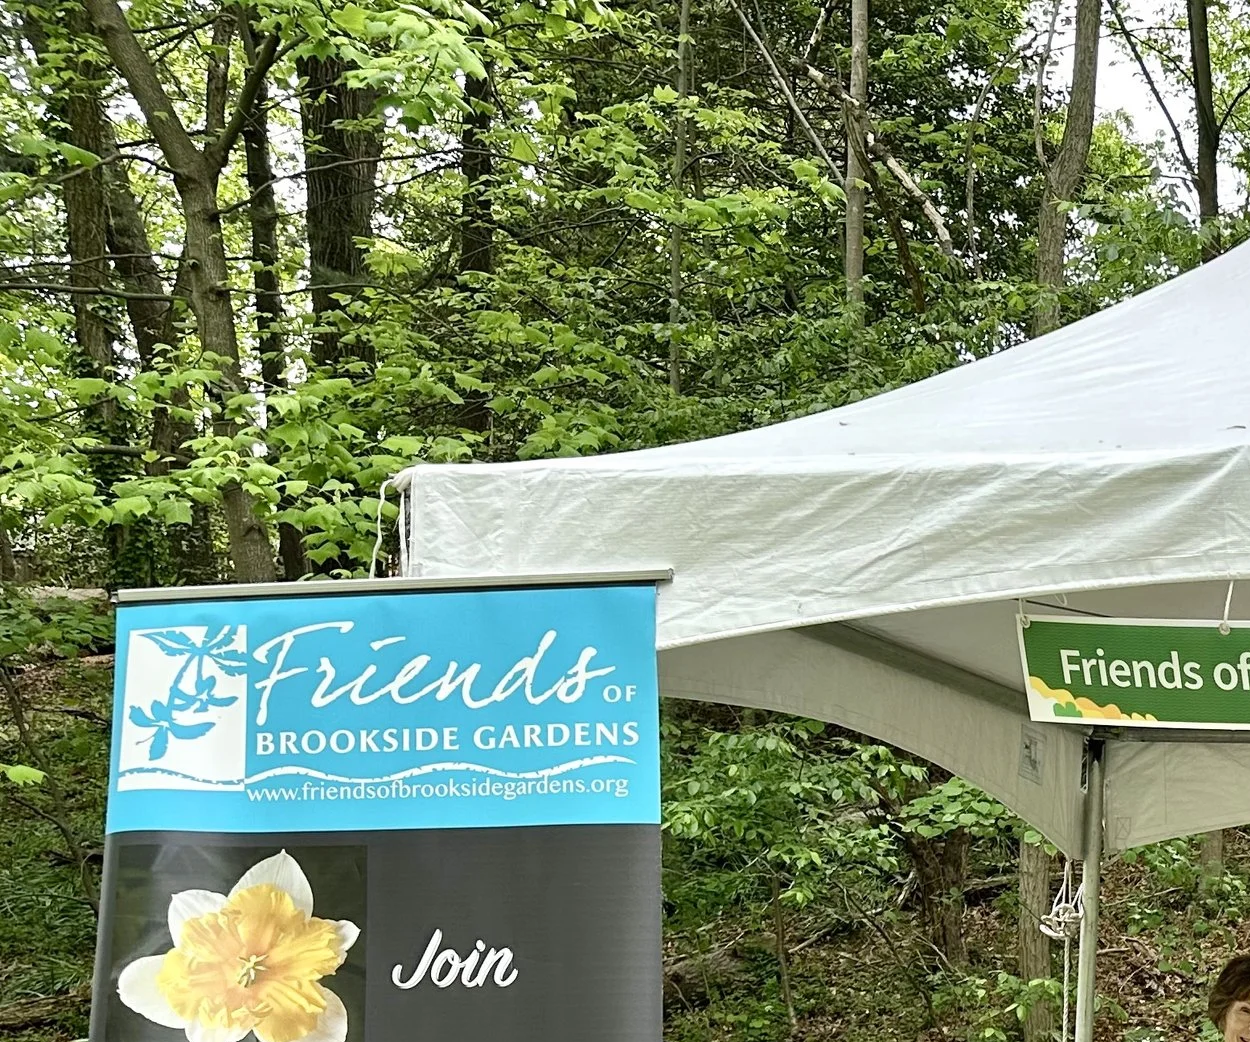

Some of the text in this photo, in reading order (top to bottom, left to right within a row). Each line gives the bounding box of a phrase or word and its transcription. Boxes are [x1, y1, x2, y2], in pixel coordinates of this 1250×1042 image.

[253, 621, 637, 725] Friends OF
[1060, 647, 1203, 691] Friends
[256, 722, 639, 757] BROOKSIDE GARDENS
[247, 775, 628, 804] www.friendsofbrooksidegardens.org
[391, 929, 518, 989] Join
